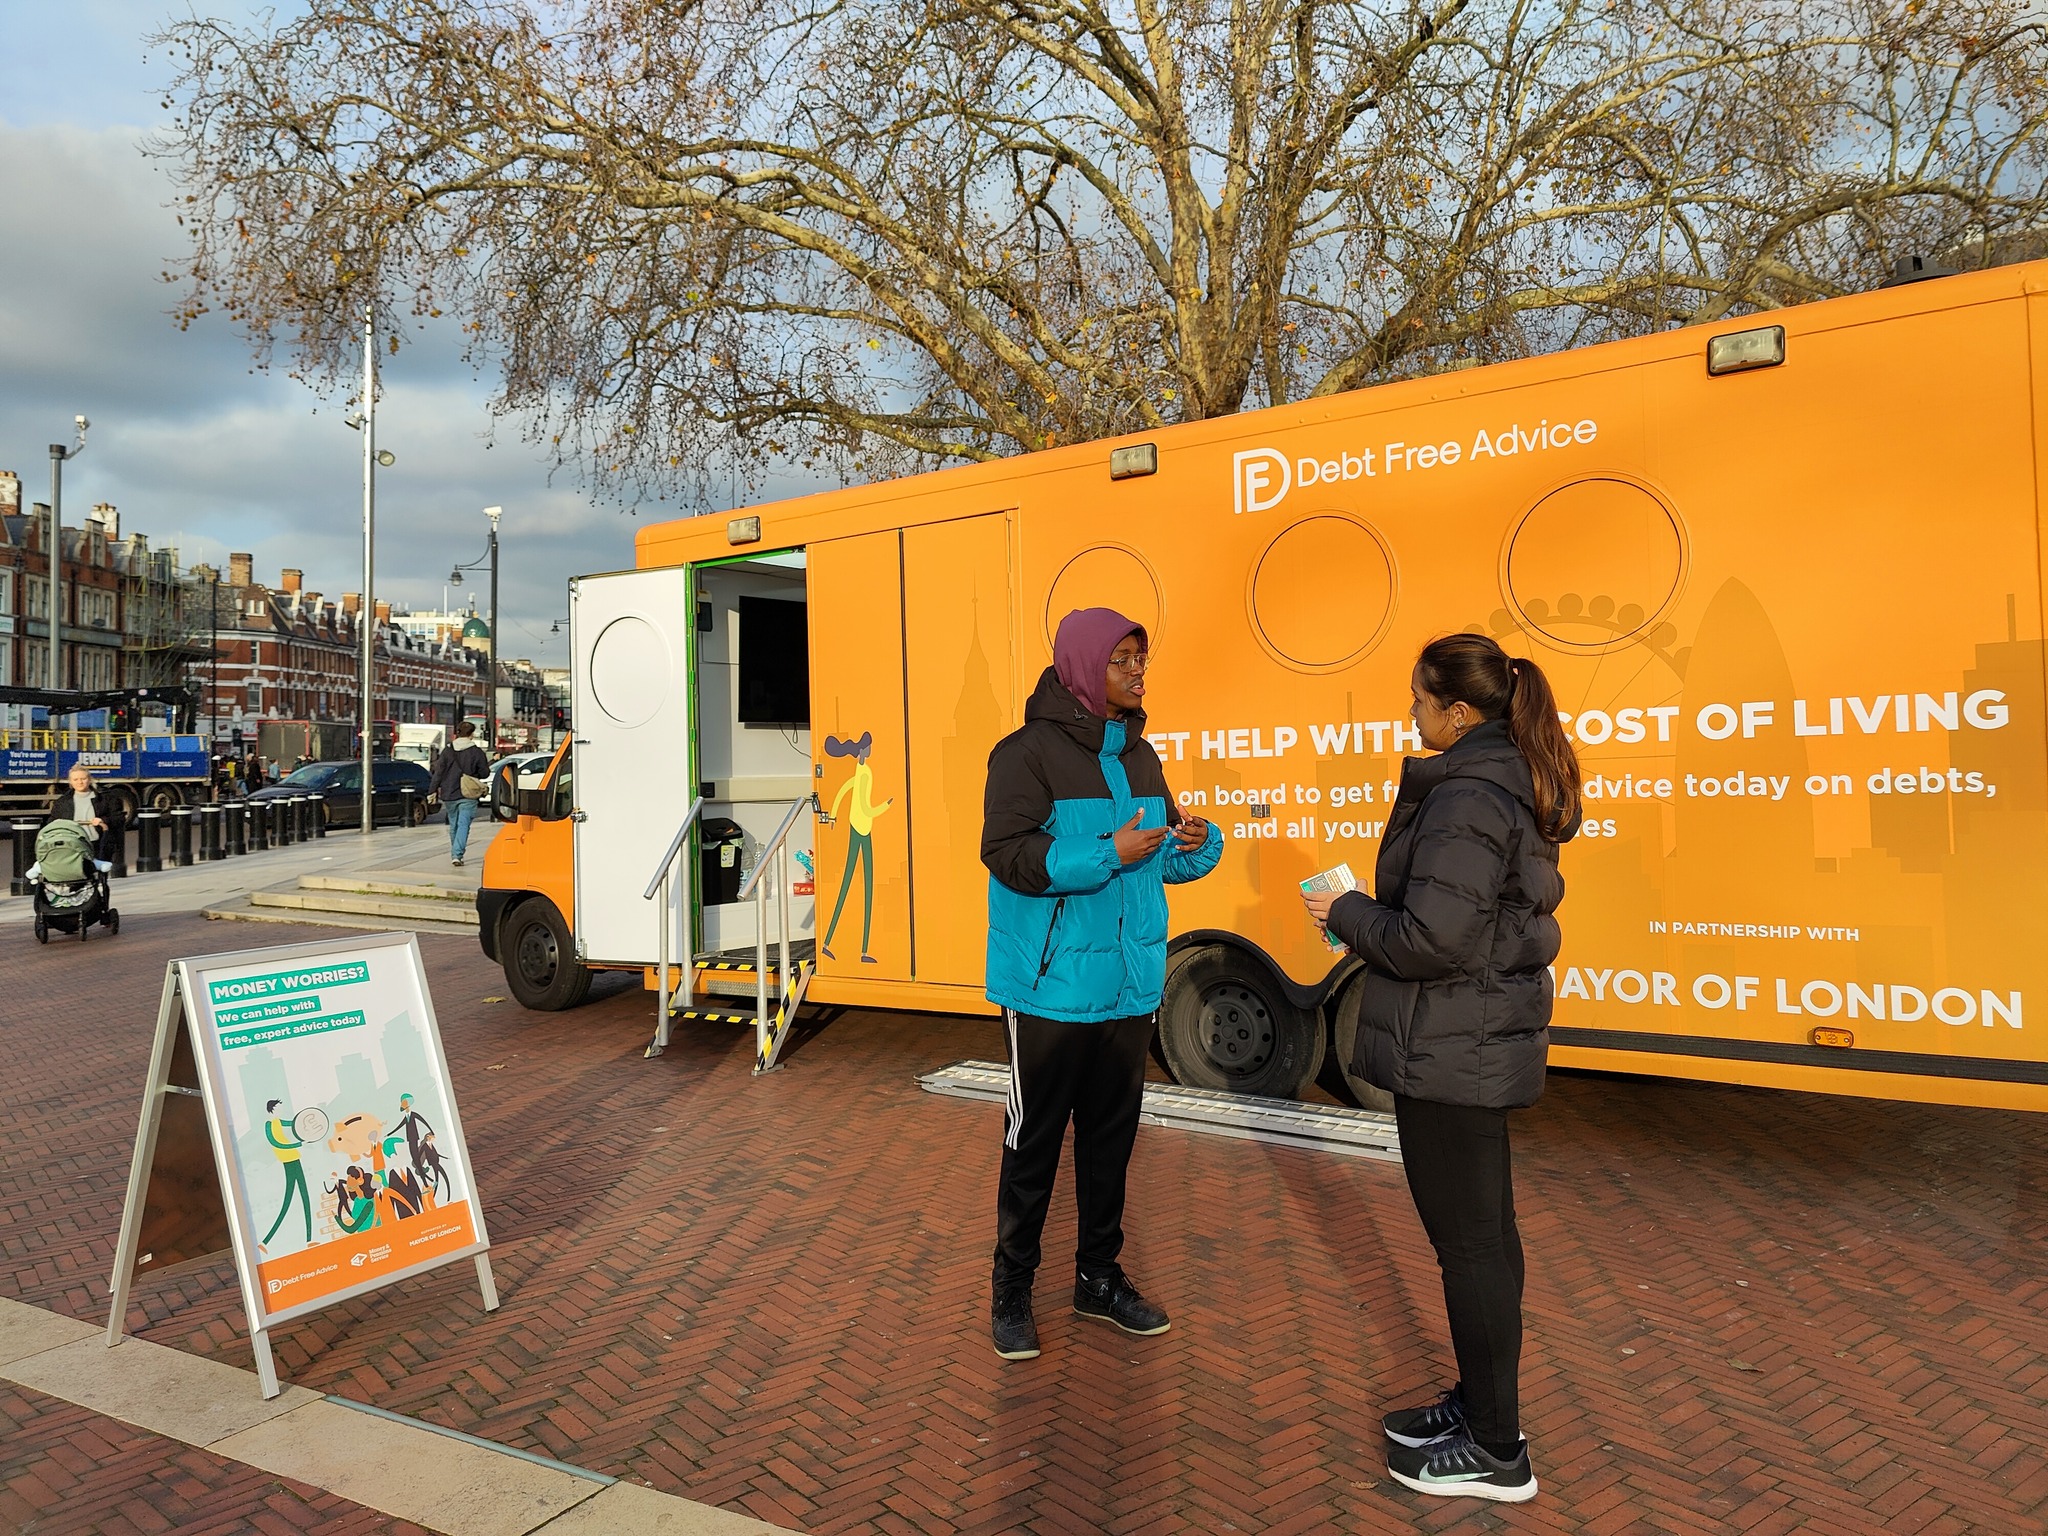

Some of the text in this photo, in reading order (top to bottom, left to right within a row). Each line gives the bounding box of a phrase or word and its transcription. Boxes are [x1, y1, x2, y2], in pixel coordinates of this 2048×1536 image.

[1297, 447, 1377, 488] Debt
[1385, 440, 1461, 474] Free
[1469, 418, 1598, 461] Advice
[1147, 731, 1190, 762] ET
[1201, 726, 1298, 760] HELP
[1309, 719, 1422, 756] WITH
[1696, 701, 1775, 740] OF
[1794, 689, 2010, 737] LIVING
[77, 752, 121, 766] JEWSON
[1178, 790, 1207, 807] on
[1214, 783, 1286, 806] board
[1294, 784, 1321, 804] to
[1329, 782, 1374, 808] get
[1583, 773, 1673, 799] dvice
[1684, 770, 1790, 801] today
[1804, 772, 1852, 796] on
[1866, 766, 1997, 798] debts,
[1233, 817, 1384, 843] and all your
[1649, 920, 1860, 942] IN PARTNERSHIP WITH
[214, 966, 365, 999] MONEY WORRIES?
[218, 1000, 316, 1024] We can help with
[1692, 973, 1760, 1010] OF
[1776, 978, 2023, 1029] LONDON
[223, 1014, 362, 1047] free, expert advice today
[409, 1225, 462, 1247] MAYOR OF LONDON
[282, 1276, 300, 1286] Debt
[300, 1271, 316, 1280] Free
[315, 1263, 338, 1275] Advice
